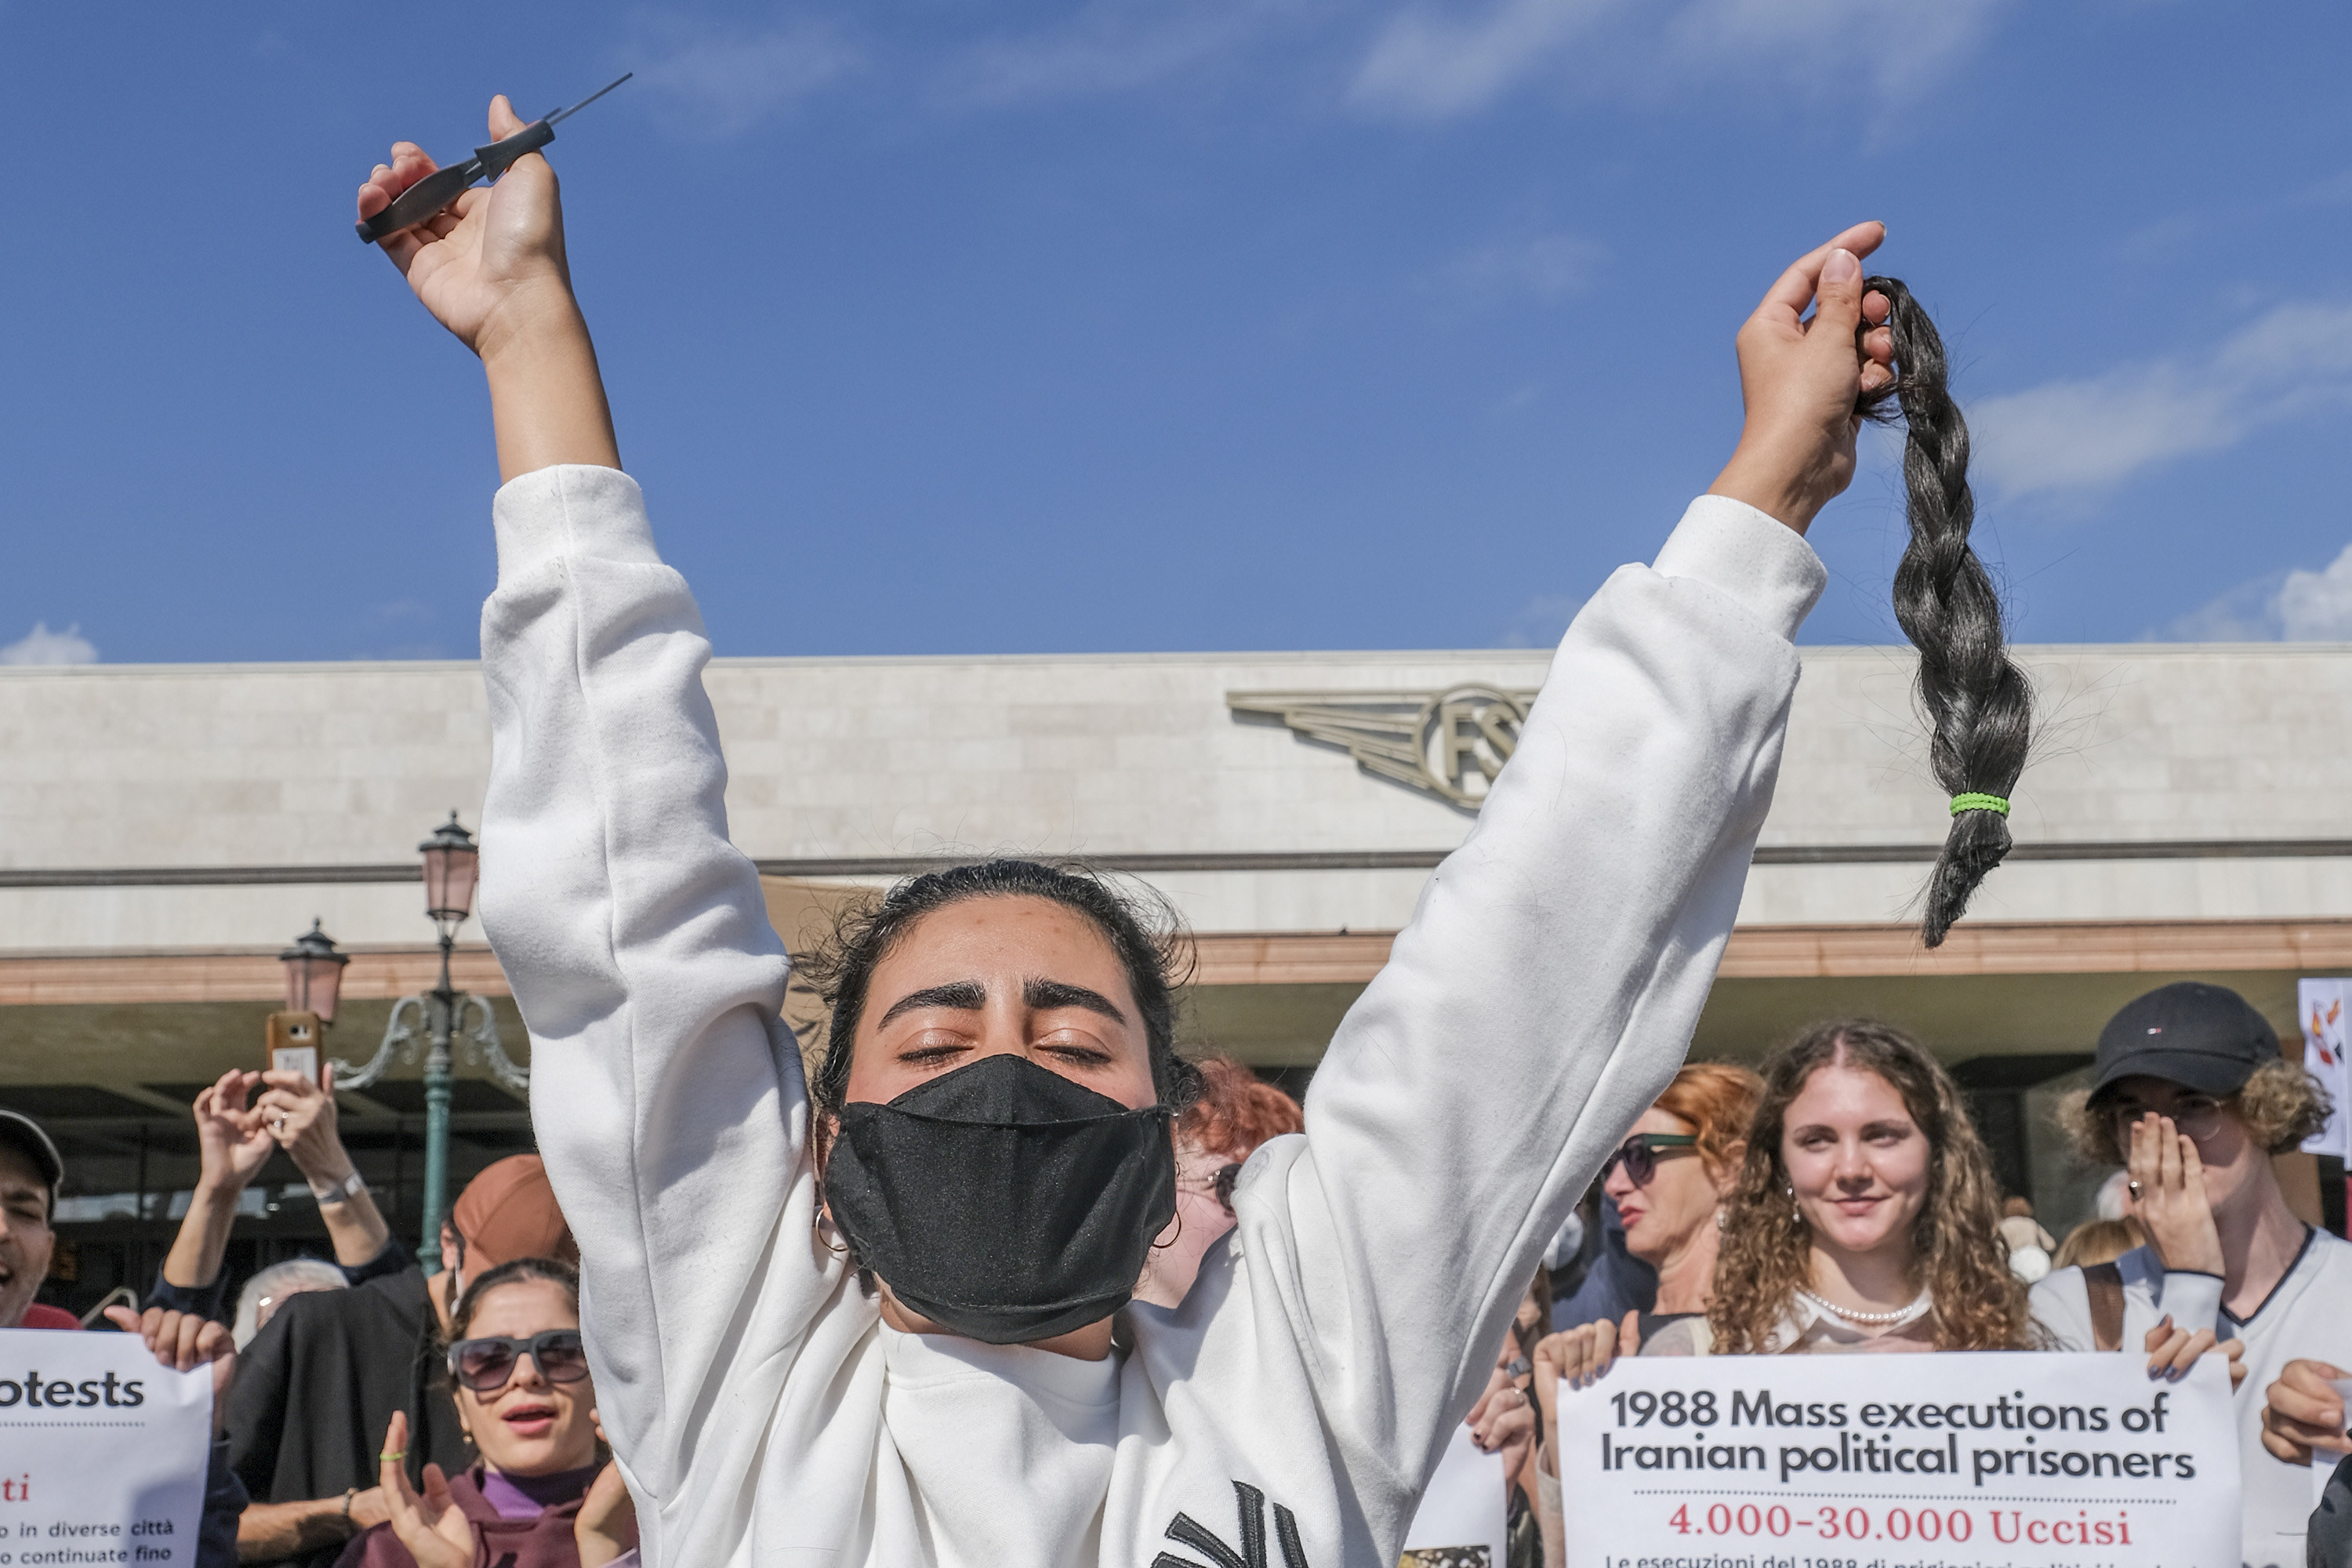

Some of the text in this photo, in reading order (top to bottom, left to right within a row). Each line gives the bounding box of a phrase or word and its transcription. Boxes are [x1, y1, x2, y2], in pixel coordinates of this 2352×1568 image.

[0, 1370, 144, 1408] otests
[1611, 1390, 2170, 1432] 1988 Mass executions of
[1602, 1432, 2195, 1486] Iranian political prisoners
[20, 1522, 38, 1537] in
[49, 1521, 121, 1537] diverse
[131, 1519, 174, 1536] città
[1669, 1503, 2132, 1545] 4.000-30.000 Uccisi
[20, 1547, 129, 1566] continuate
[135, 1545, 172, 1562] fino
[1636, 1553, 1755, 1568] esecuzioni
